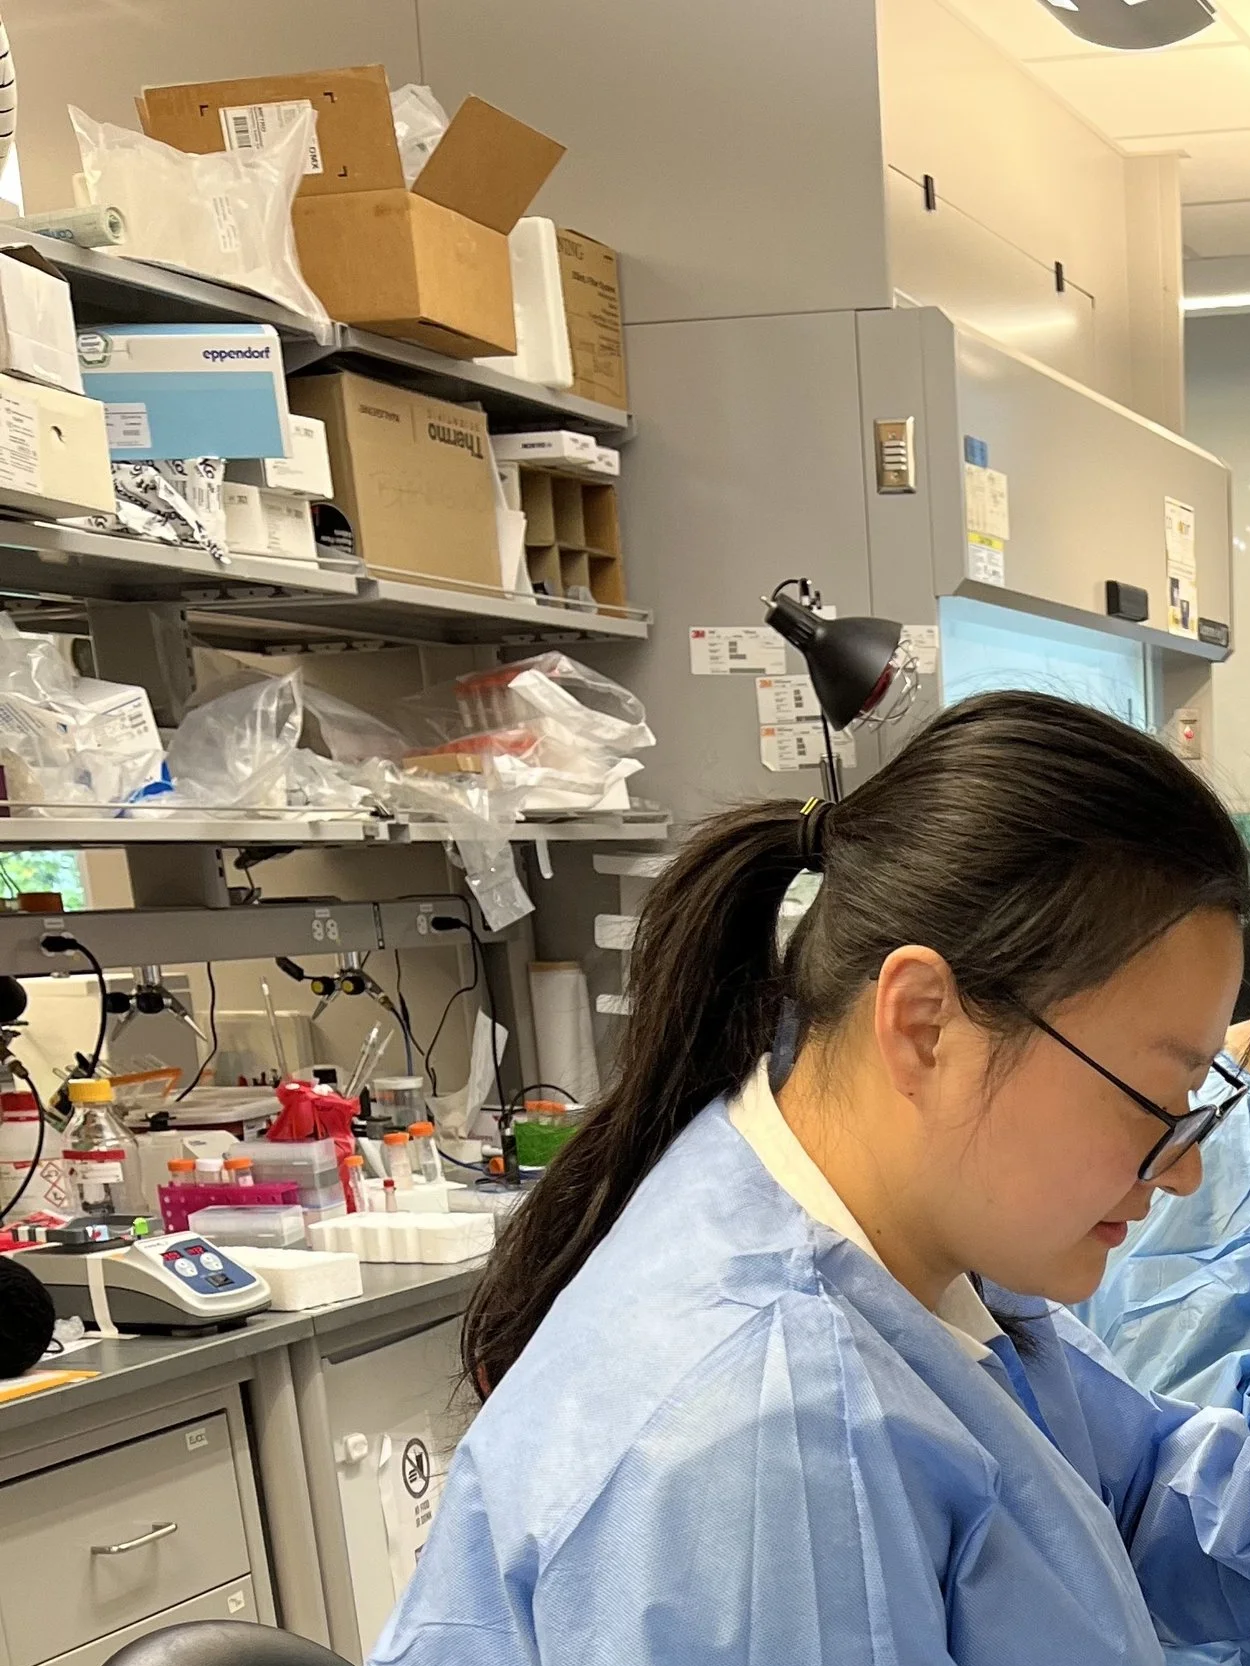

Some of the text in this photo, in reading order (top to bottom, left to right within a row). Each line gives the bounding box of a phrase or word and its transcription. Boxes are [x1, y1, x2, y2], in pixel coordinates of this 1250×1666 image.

[202, 347, 271, 362] eppendorf
[427, 422, 484, 460] Thermo
[691, 629, 706, 639] 3M
